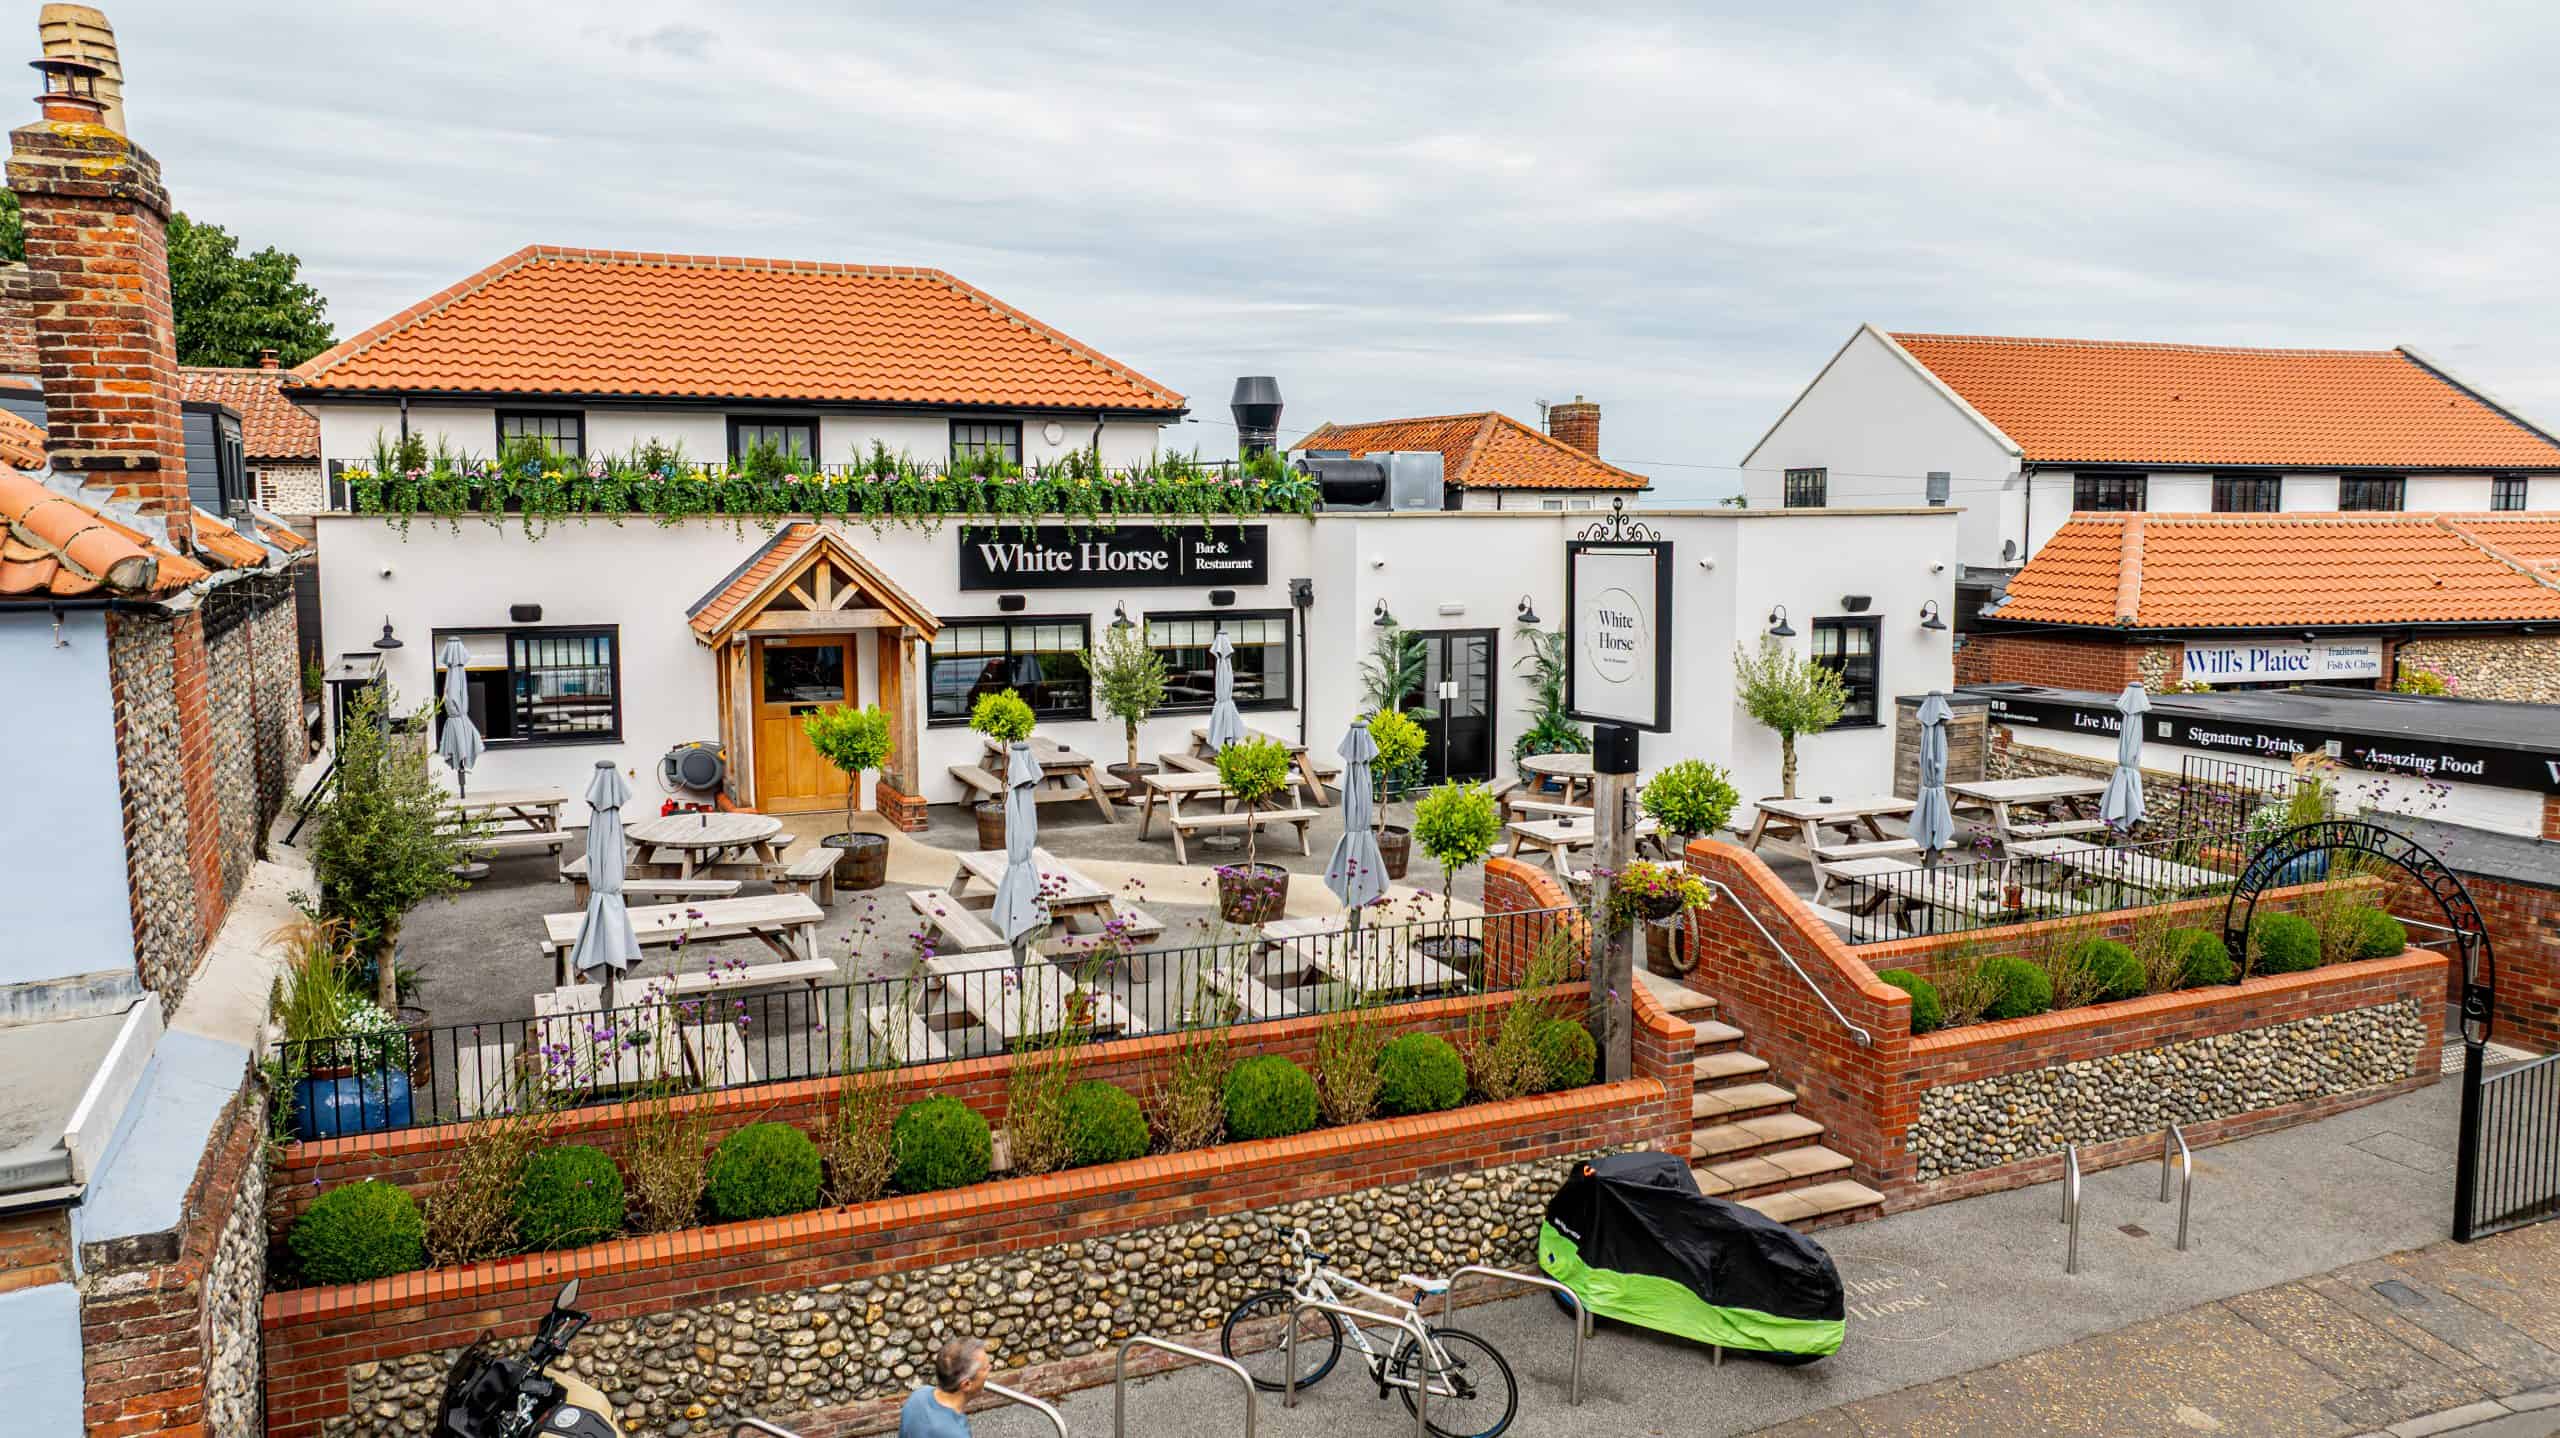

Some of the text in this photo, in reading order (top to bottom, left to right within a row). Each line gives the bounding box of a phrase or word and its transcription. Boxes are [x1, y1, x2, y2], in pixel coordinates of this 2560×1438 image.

[1195, 541, 1229, 553] Bar &
[978, 542, 1168, 573] White Horse
[1195, 557, 1253, 569] Restaurant
[1599, 610, 1632, 628] White
[1599, 631, 1632, 650] Horse
[2186, 648, 2311, 673] Will's Plaice
[2328, 647, 2369, 656] Traditional
[2327, 659, 2377, 671] Fish & Chips
[2074, 712, 2099, 728] Live
[2188, 727, 2304, 753] Signature Drinks
[2365, 748, 2484, 775] Amazing Food
[2237, 823, 2487, 948] WHEELCHAIR ACCESS
